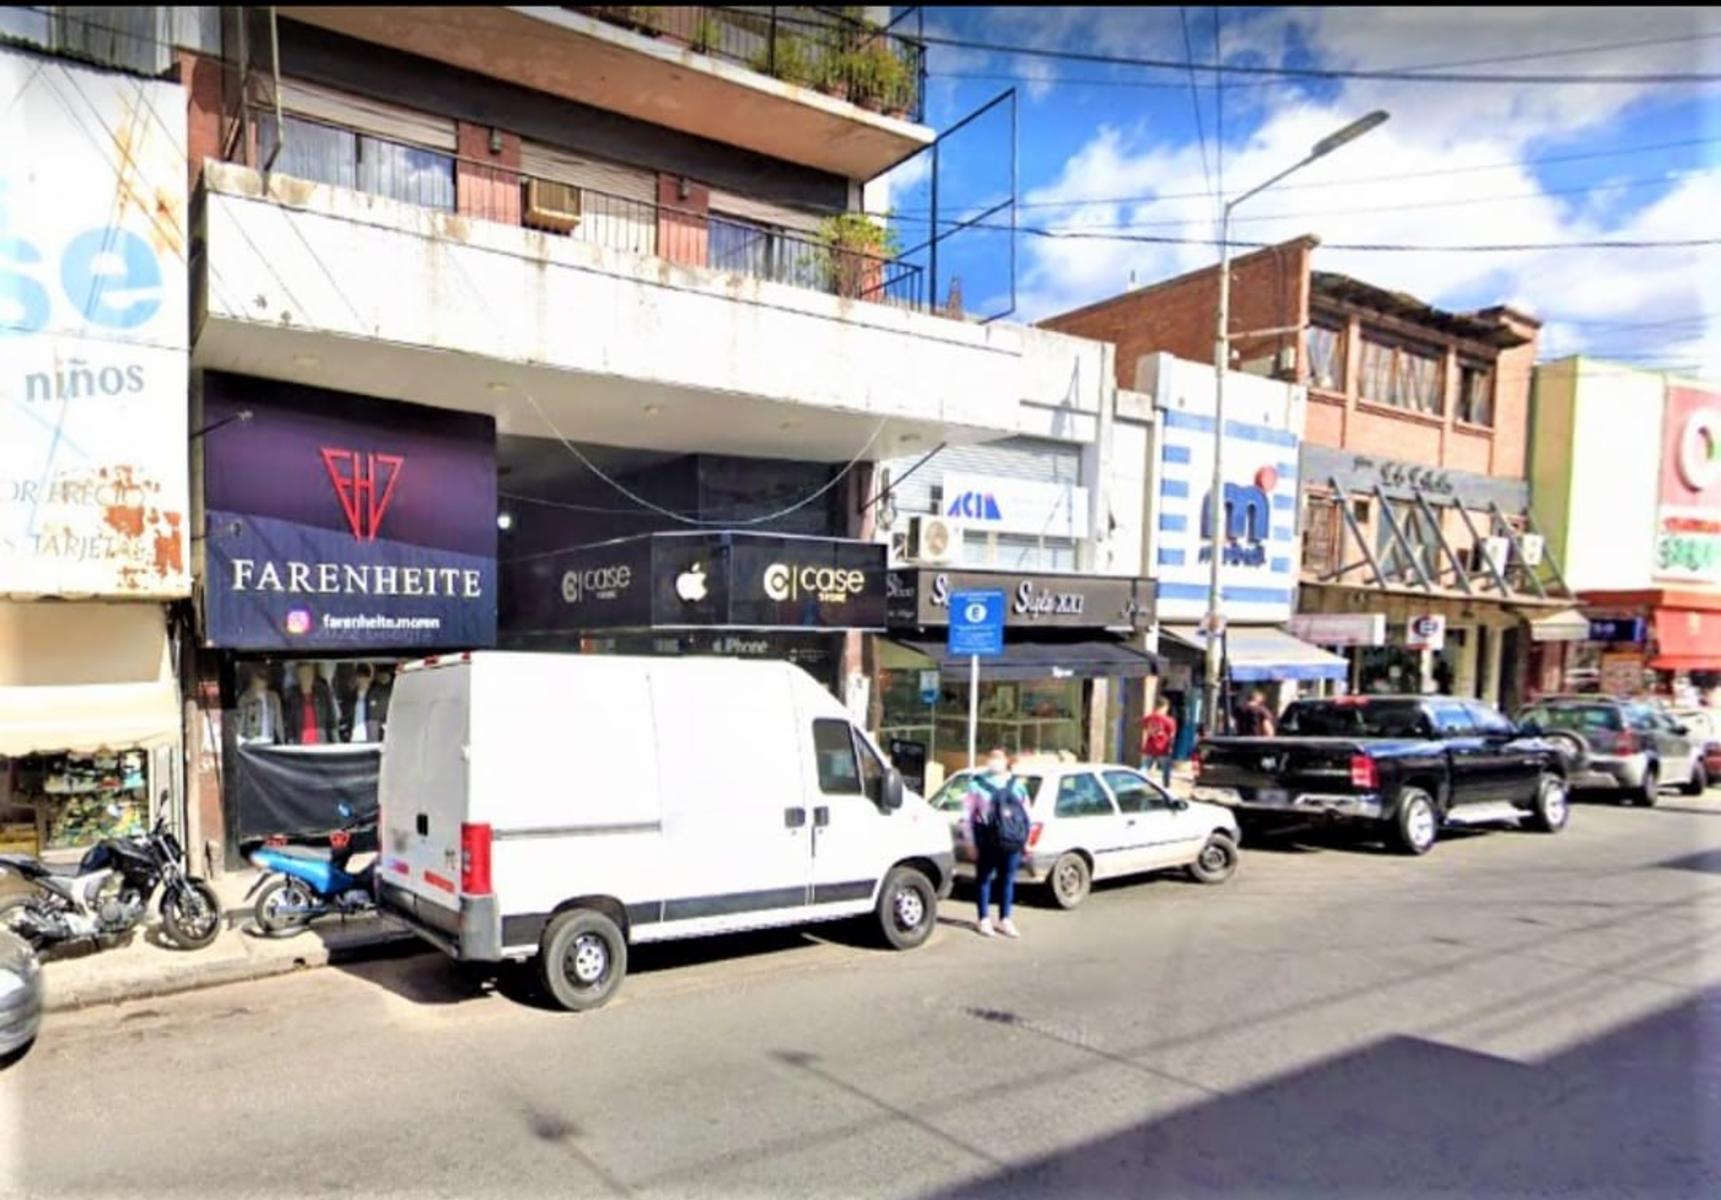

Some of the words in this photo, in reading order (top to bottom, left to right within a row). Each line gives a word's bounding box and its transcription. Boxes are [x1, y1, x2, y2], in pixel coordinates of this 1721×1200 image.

[25, 358, 145, 402] niños
[231, 559, 482, 598] FARENHEITE
[584, 564, 632, 591] case
[799, 564, 866, 594] case
